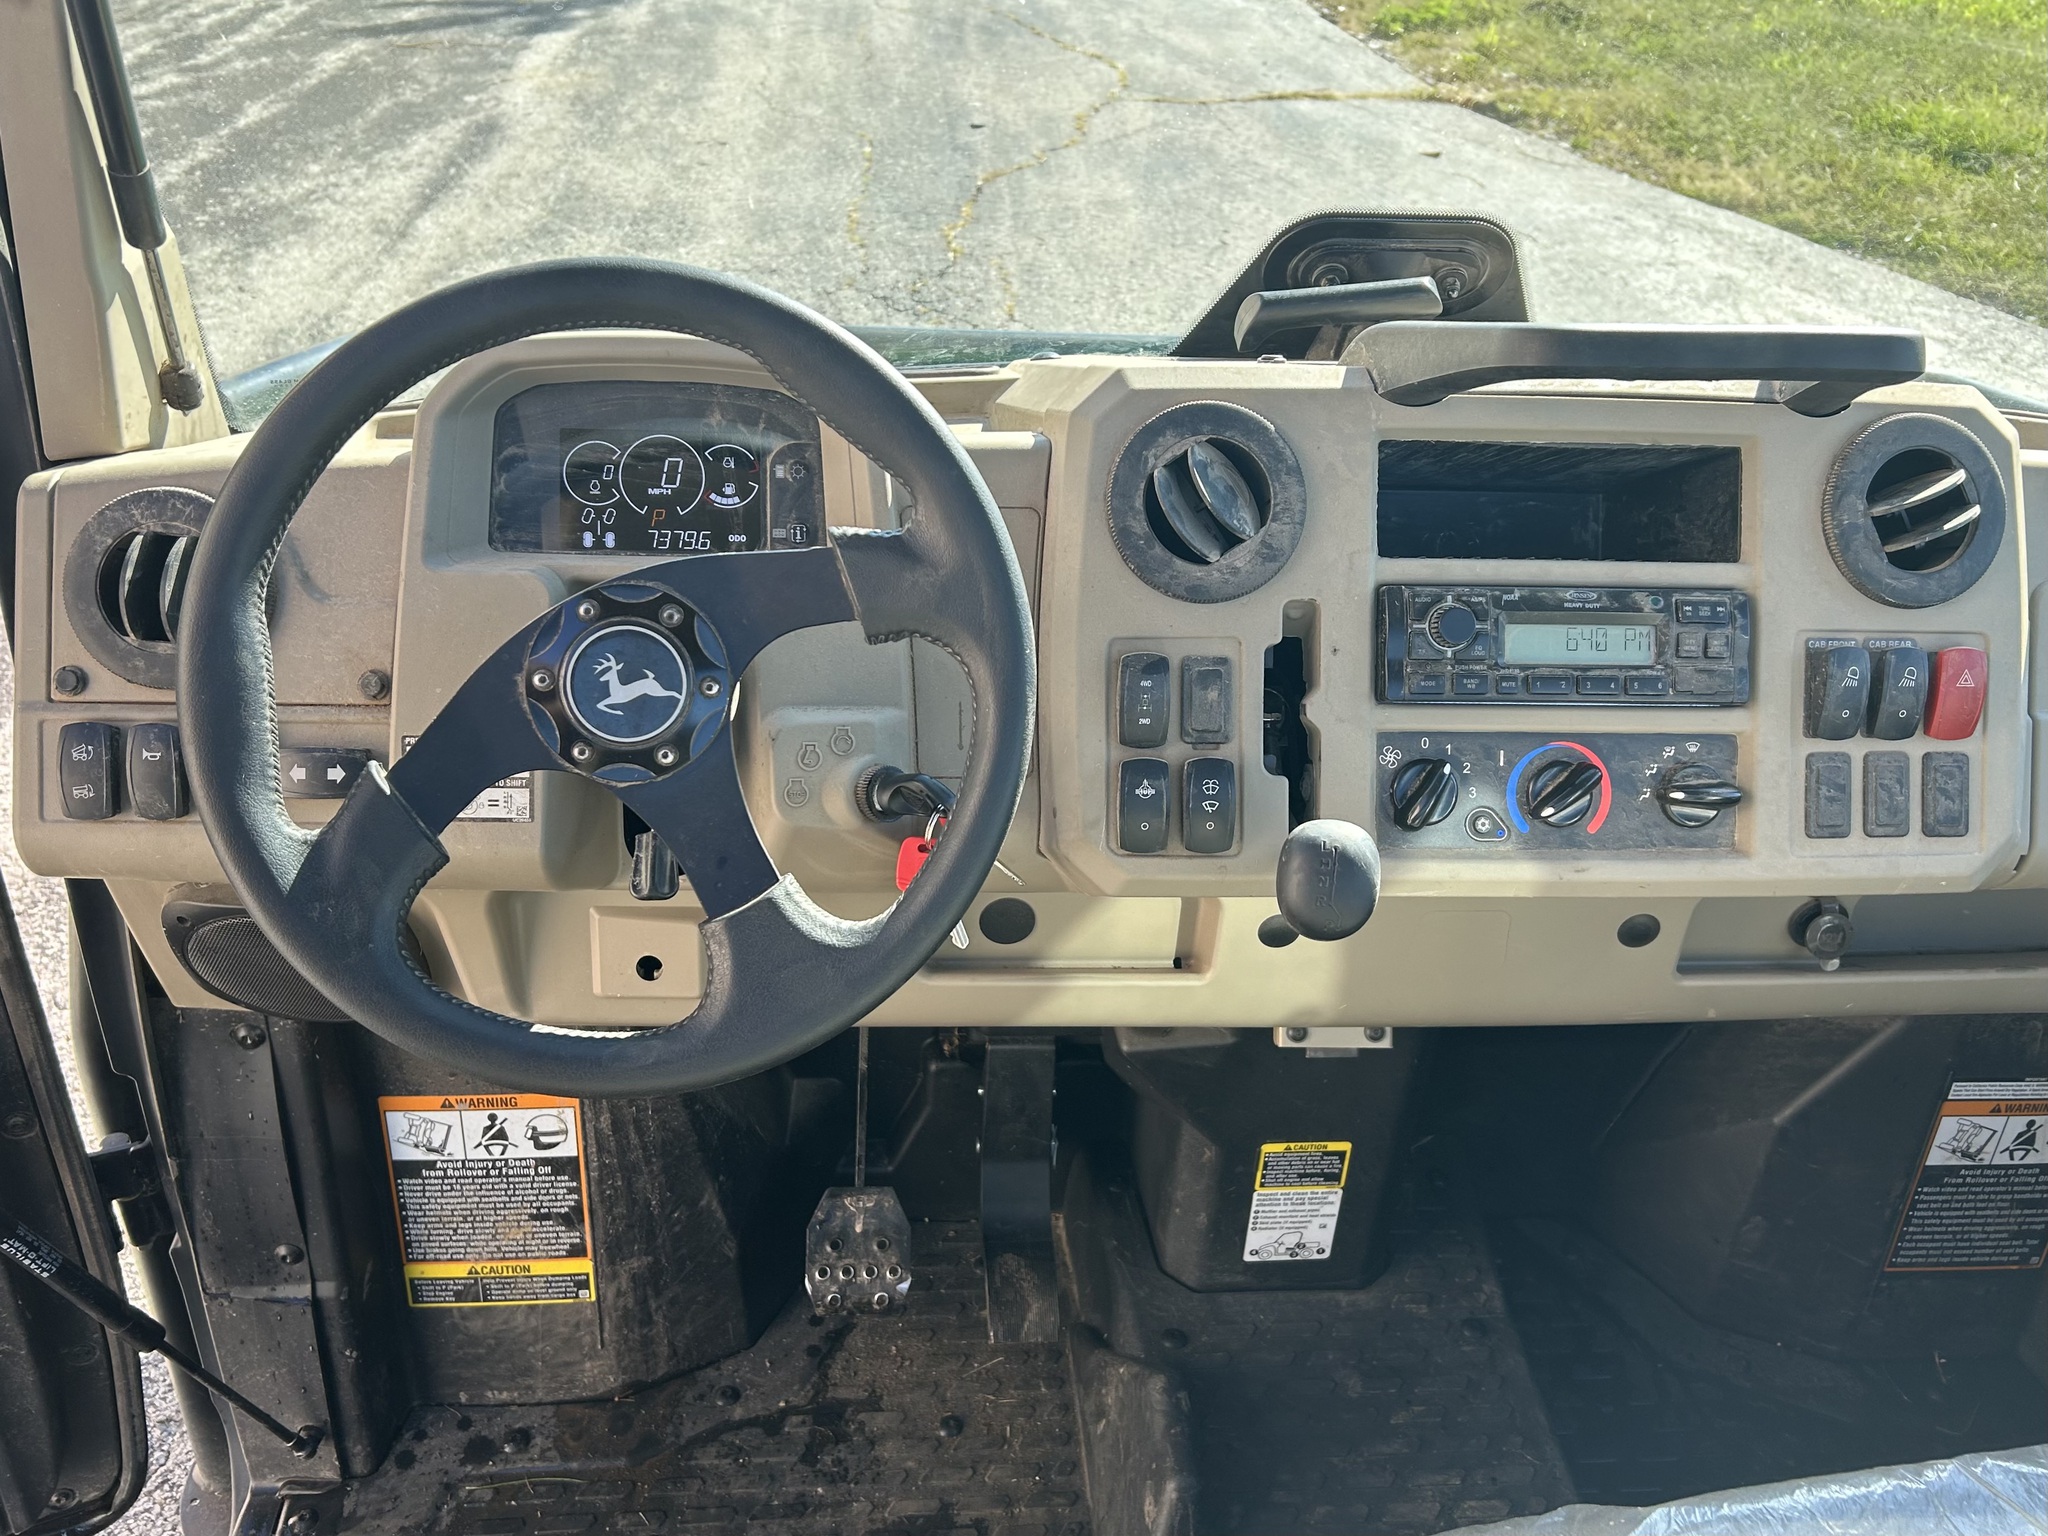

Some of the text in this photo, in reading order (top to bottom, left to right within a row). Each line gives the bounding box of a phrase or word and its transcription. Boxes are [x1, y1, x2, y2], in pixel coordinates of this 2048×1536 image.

[603, 464, 614, 480] 0
[662, 458, 683, 488] 0
[652, 509, 666, 526] P
[648, 530, 711, 549] 7379.6
[1625, 628, 1650, 651] PM
[1421, 738, 1429, 749] 0
[1446, 744, 1451, 755] 1
[1463, 763, 1470, 774] 2
[1469, 787, 1477, 798] 3
[1322, 840, 1330, 852] L
[1316, 896, 1326, 906] R
[456, 1097, 518, 1109] WARNING
[2005, 1104, 2048, 1113] WARNIN
[466, 1160, 492, 1168] Injury
[502, 1167, 535, 1176] Falling
[0, 1243, 50, 1278] STABILUS
[481, 1265, 531, 1275] CAUTION
